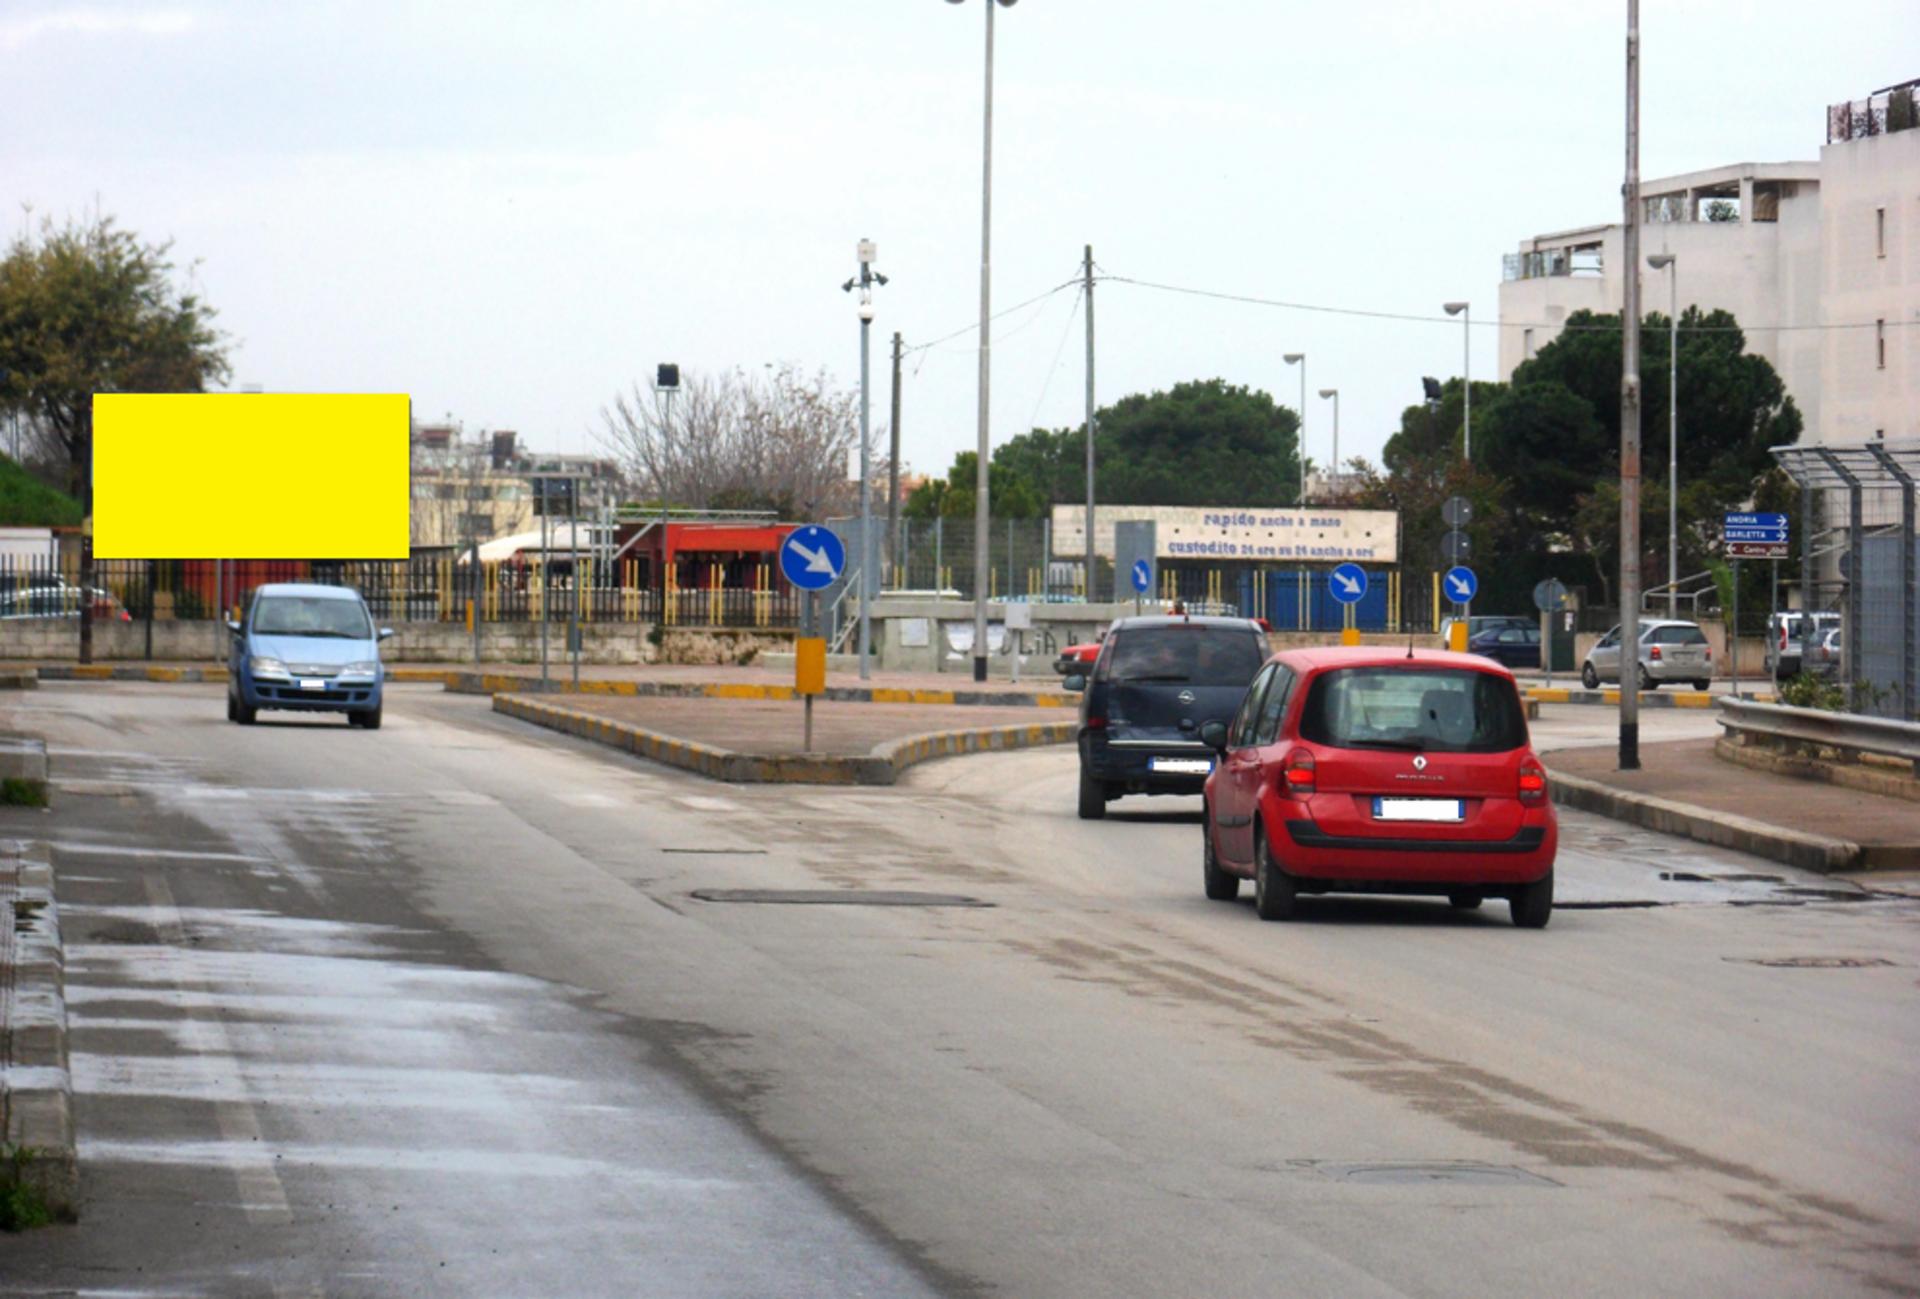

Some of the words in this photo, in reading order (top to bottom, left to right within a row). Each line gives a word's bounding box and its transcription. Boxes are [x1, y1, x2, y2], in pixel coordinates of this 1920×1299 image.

[1204, 512, 1256, 527] rapido
[1260, 516, 1294, 527] anche
[1310, 517, 1342, 527] mano
[1727, 515, 1757, 524] ANDRIA
[1726, 530, 1766, 539] BARLETTA
[1168, 540, 1236, 555] custodito
[1258, 546, 1275, 556] ore
[1311, 546, 1344, 557] anche
